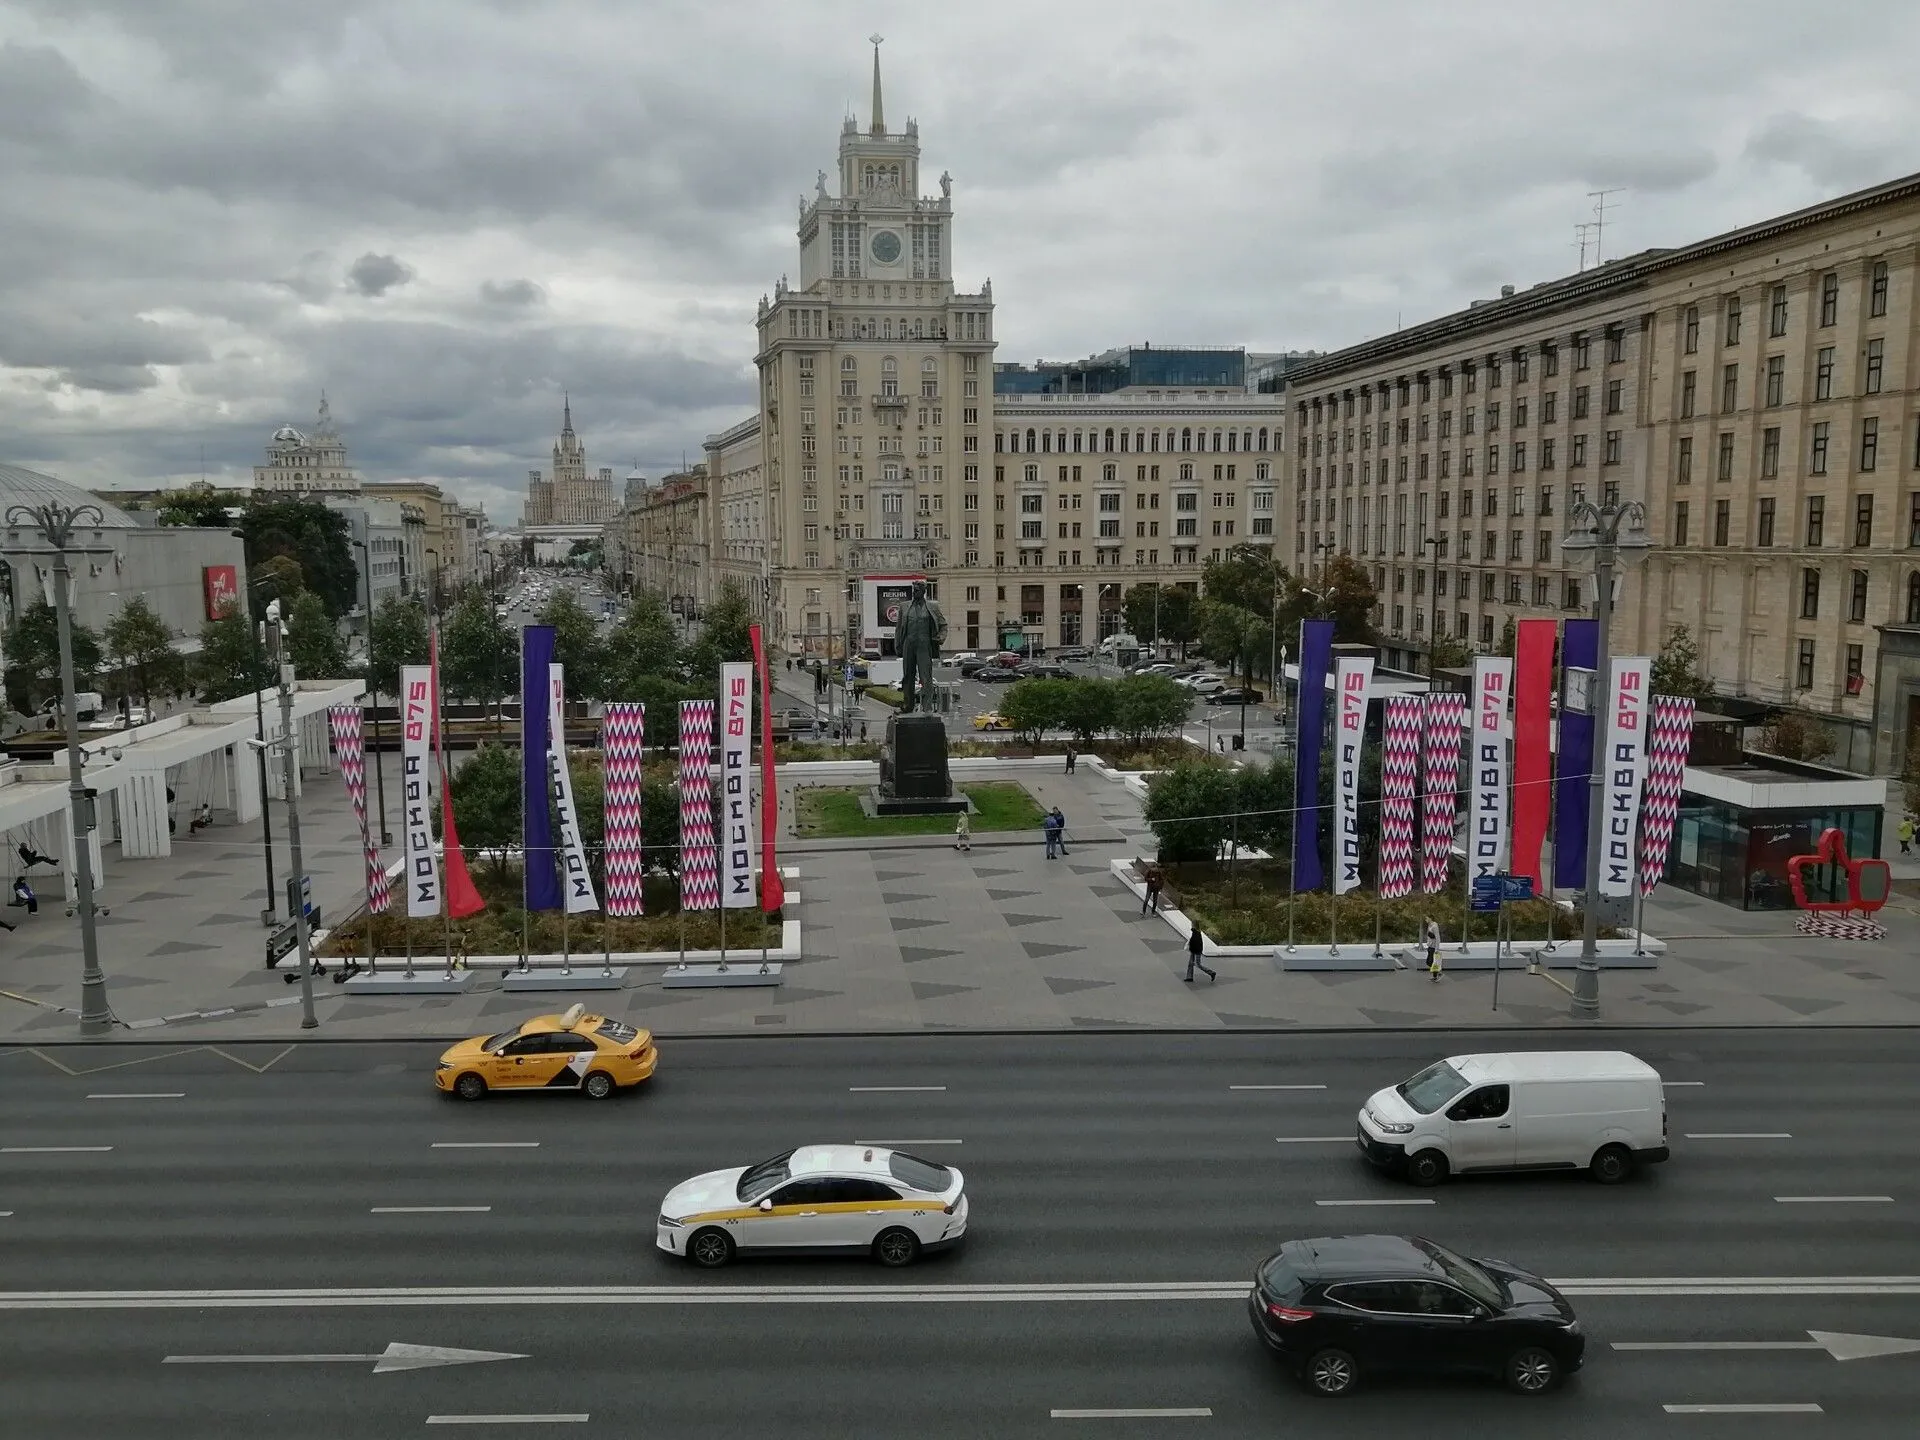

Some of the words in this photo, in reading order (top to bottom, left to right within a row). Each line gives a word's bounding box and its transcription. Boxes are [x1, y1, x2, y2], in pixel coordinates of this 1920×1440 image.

[406, 681, 427, 742] 875
[728, 678, 746, 737] 875
[1343, 672, 1365, 731] 875
[1482, 672, 1503, 731] 875
[1617, 671, 1641, 731] 875
[405, 755, 435, 903] МОСКВА
[727, 750, 750, 895] МОСКВА
[1343, 744, 1361, 882] МОСКВА
[1477, 744, 1499, 878] МОСКВА
[1608, 743, 1636, 884] МОСКВА
